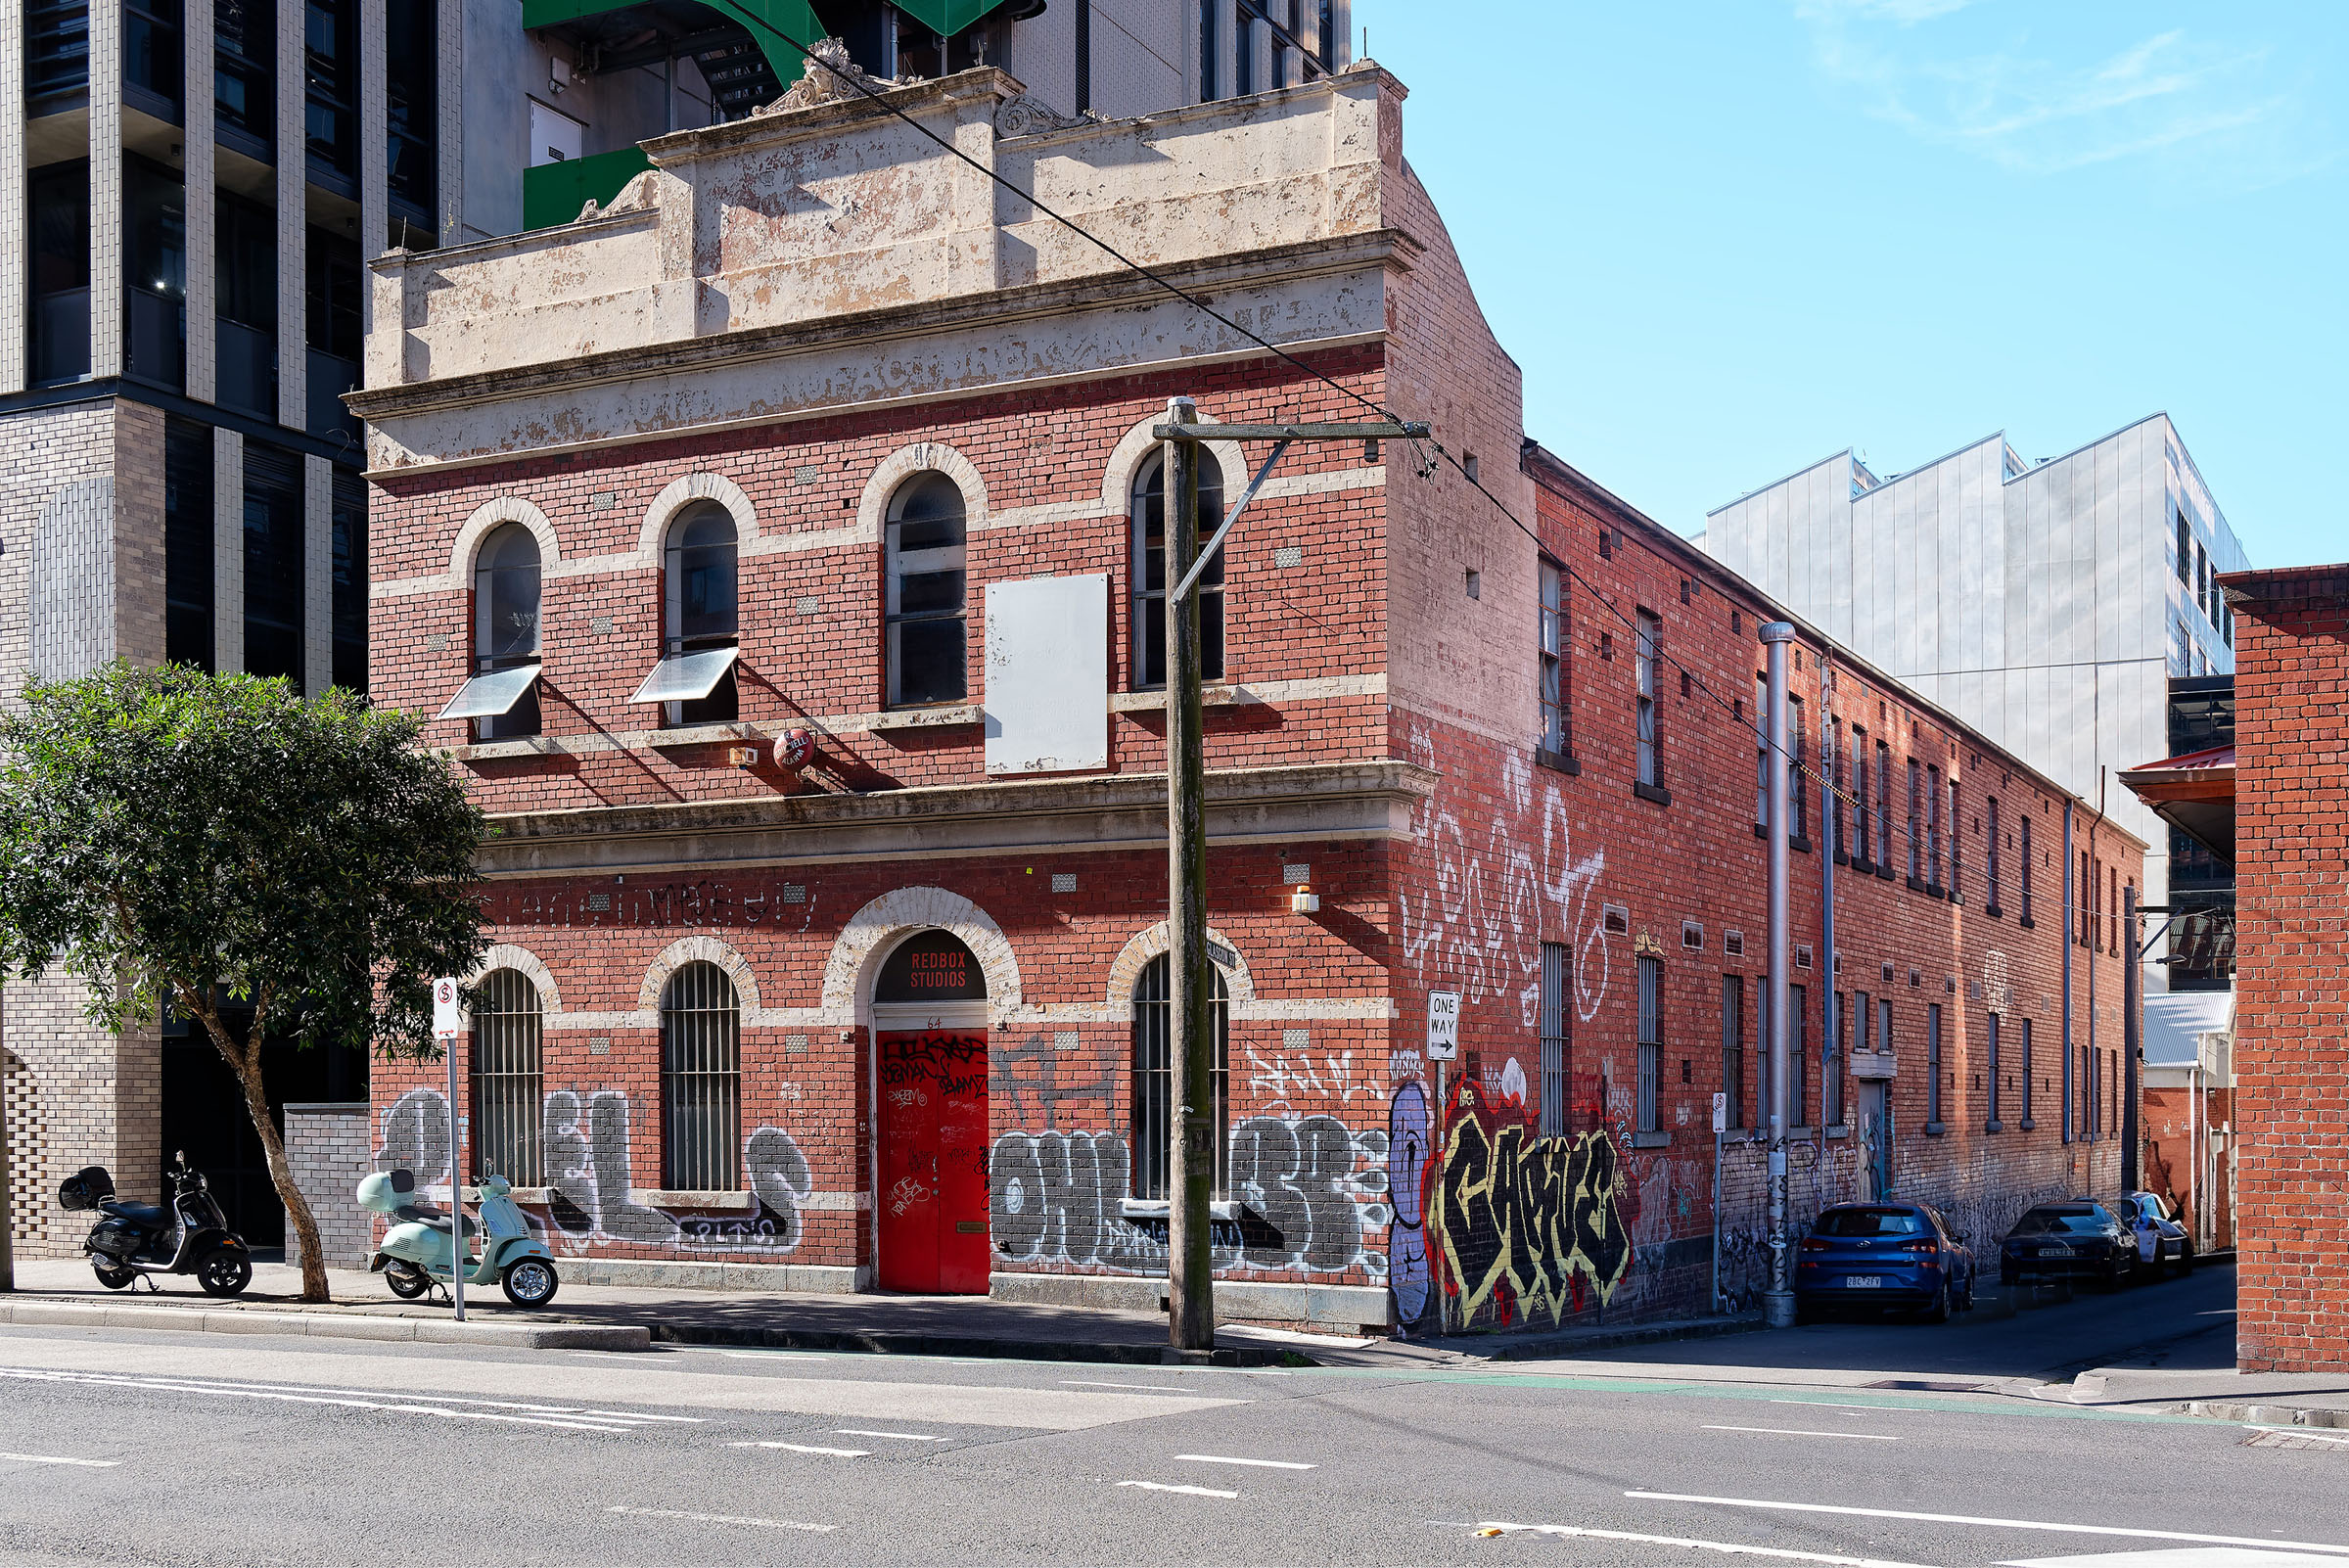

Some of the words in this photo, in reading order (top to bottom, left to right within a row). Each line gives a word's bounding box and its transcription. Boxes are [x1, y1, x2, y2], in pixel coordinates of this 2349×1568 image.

[782, 749, 805, 765] ALARM
[911, 951, 966, 969] REDBOX
[910, 971, 966, 988] STUDIOS
[1434, 997, 1454, 1014] ONE
[927, 1016, 942, 1029] 64
[1431, 1018, 1454, 1035] WAY
